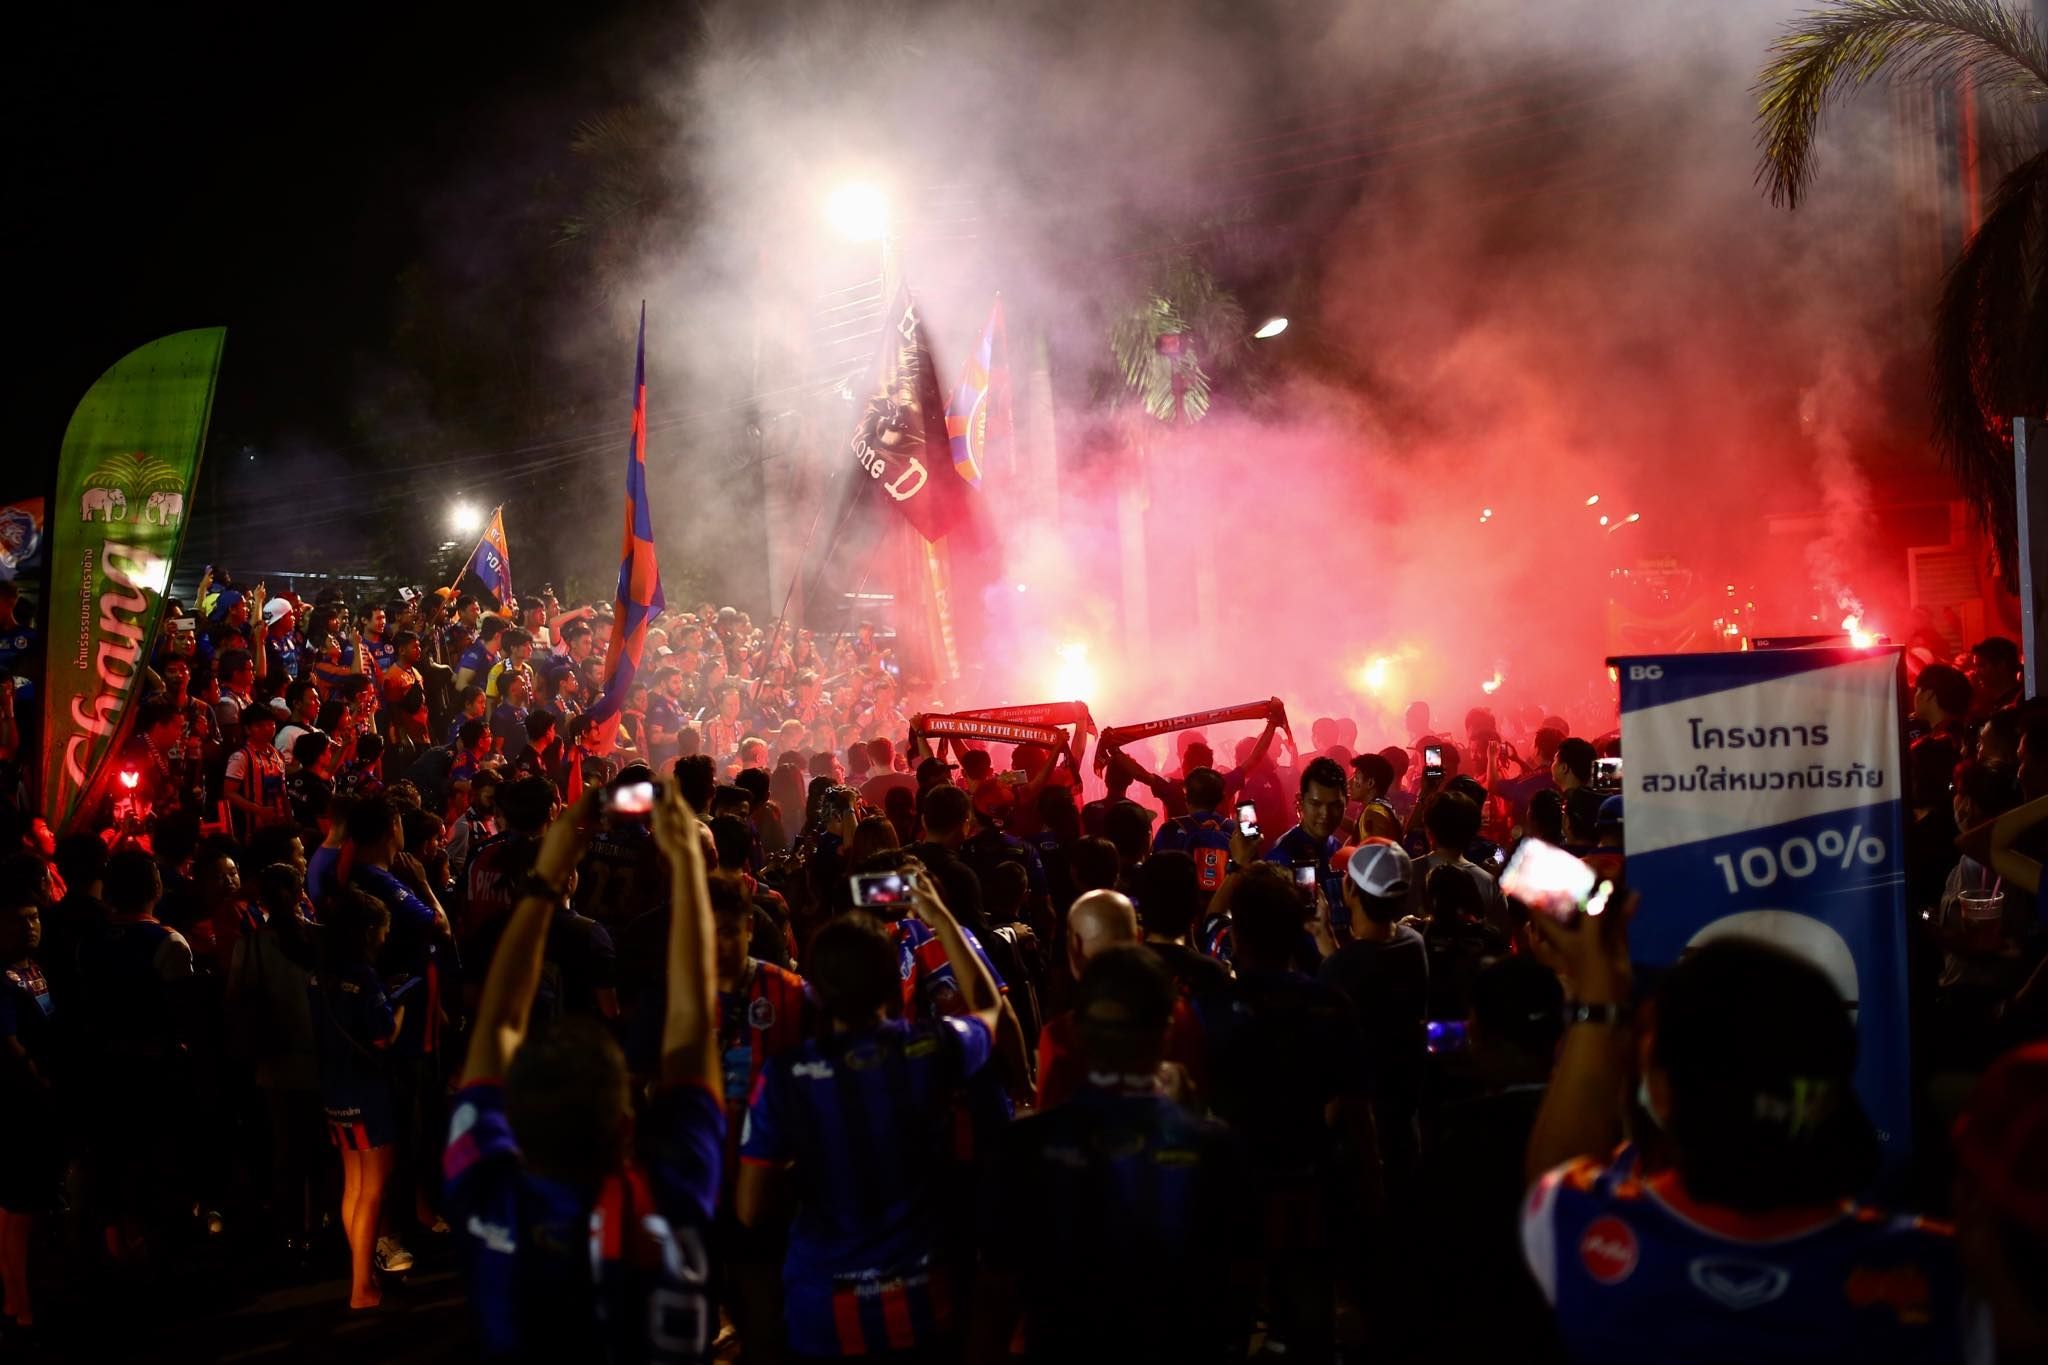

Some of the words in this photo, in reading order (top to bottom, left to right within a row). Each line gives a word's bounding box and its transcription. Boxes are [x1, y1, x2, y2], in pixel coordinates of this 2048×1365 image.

[884, 457, 928, 501] D
[1629, 664, 1664, 681] BG
[930, 721, 955, 731] LOVE
[958, 722, 978, 732] AND
[980, 724, 1011, 736] FAITH
[1688, 717, 1830, 751] โครงการ
[1641, 762, 1884, 794] สวมใส่หมวกนิรภัย
[1714, 824, 1886, 894] 100%
